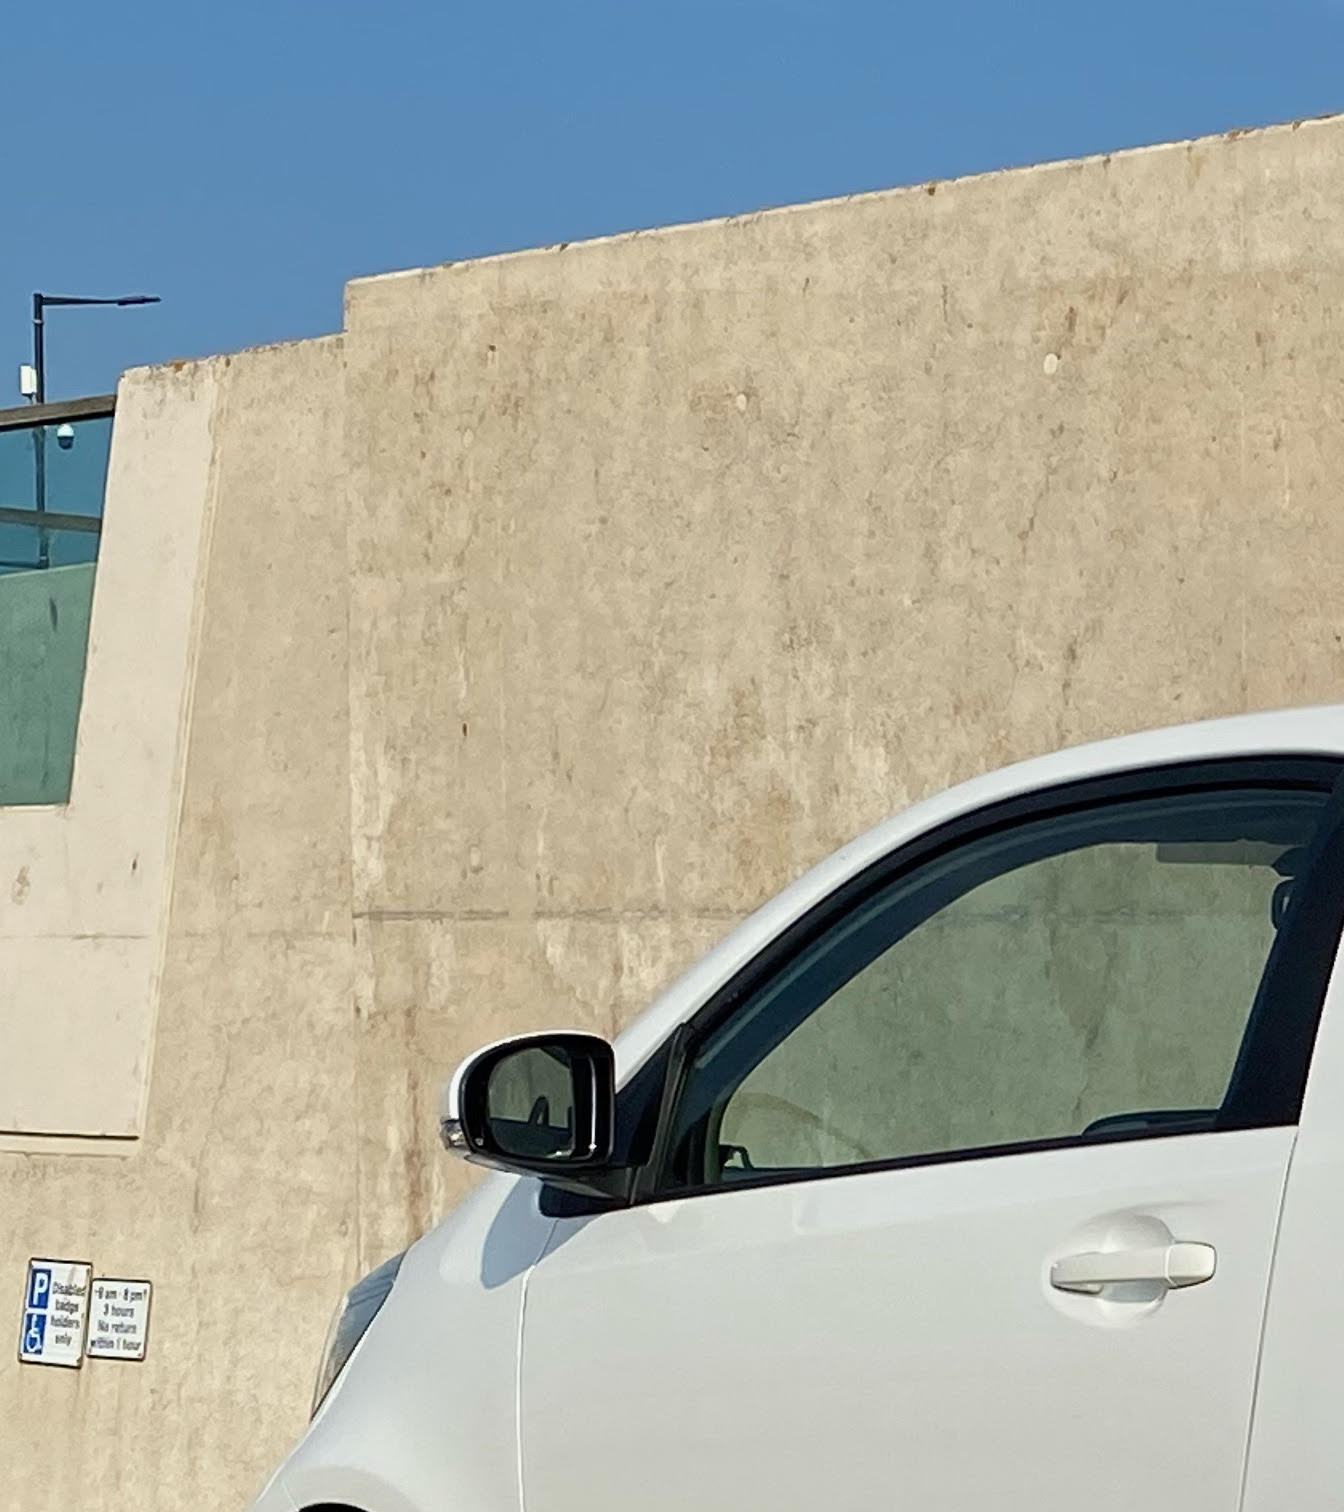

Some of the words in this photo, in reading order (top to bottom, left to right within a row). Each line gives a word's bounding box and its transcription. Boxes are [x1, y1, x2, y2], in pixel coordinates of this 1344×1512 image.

[33, 1272, 48, 1305] P
[52, 1281, 86, 1297] Disabled
[55, 1299, 79, 1315] badge
[111, 1305, 135, 1318] hours
[51, 1315, 80, 1329] holders
[97, 1320, 109, 1332] No
[112, 1322, 137, 1334] return
[55, 1332, 72, 1346] only
[91, 1337, 114, 1349] within
[123, 1339, 142, 1351] hour
